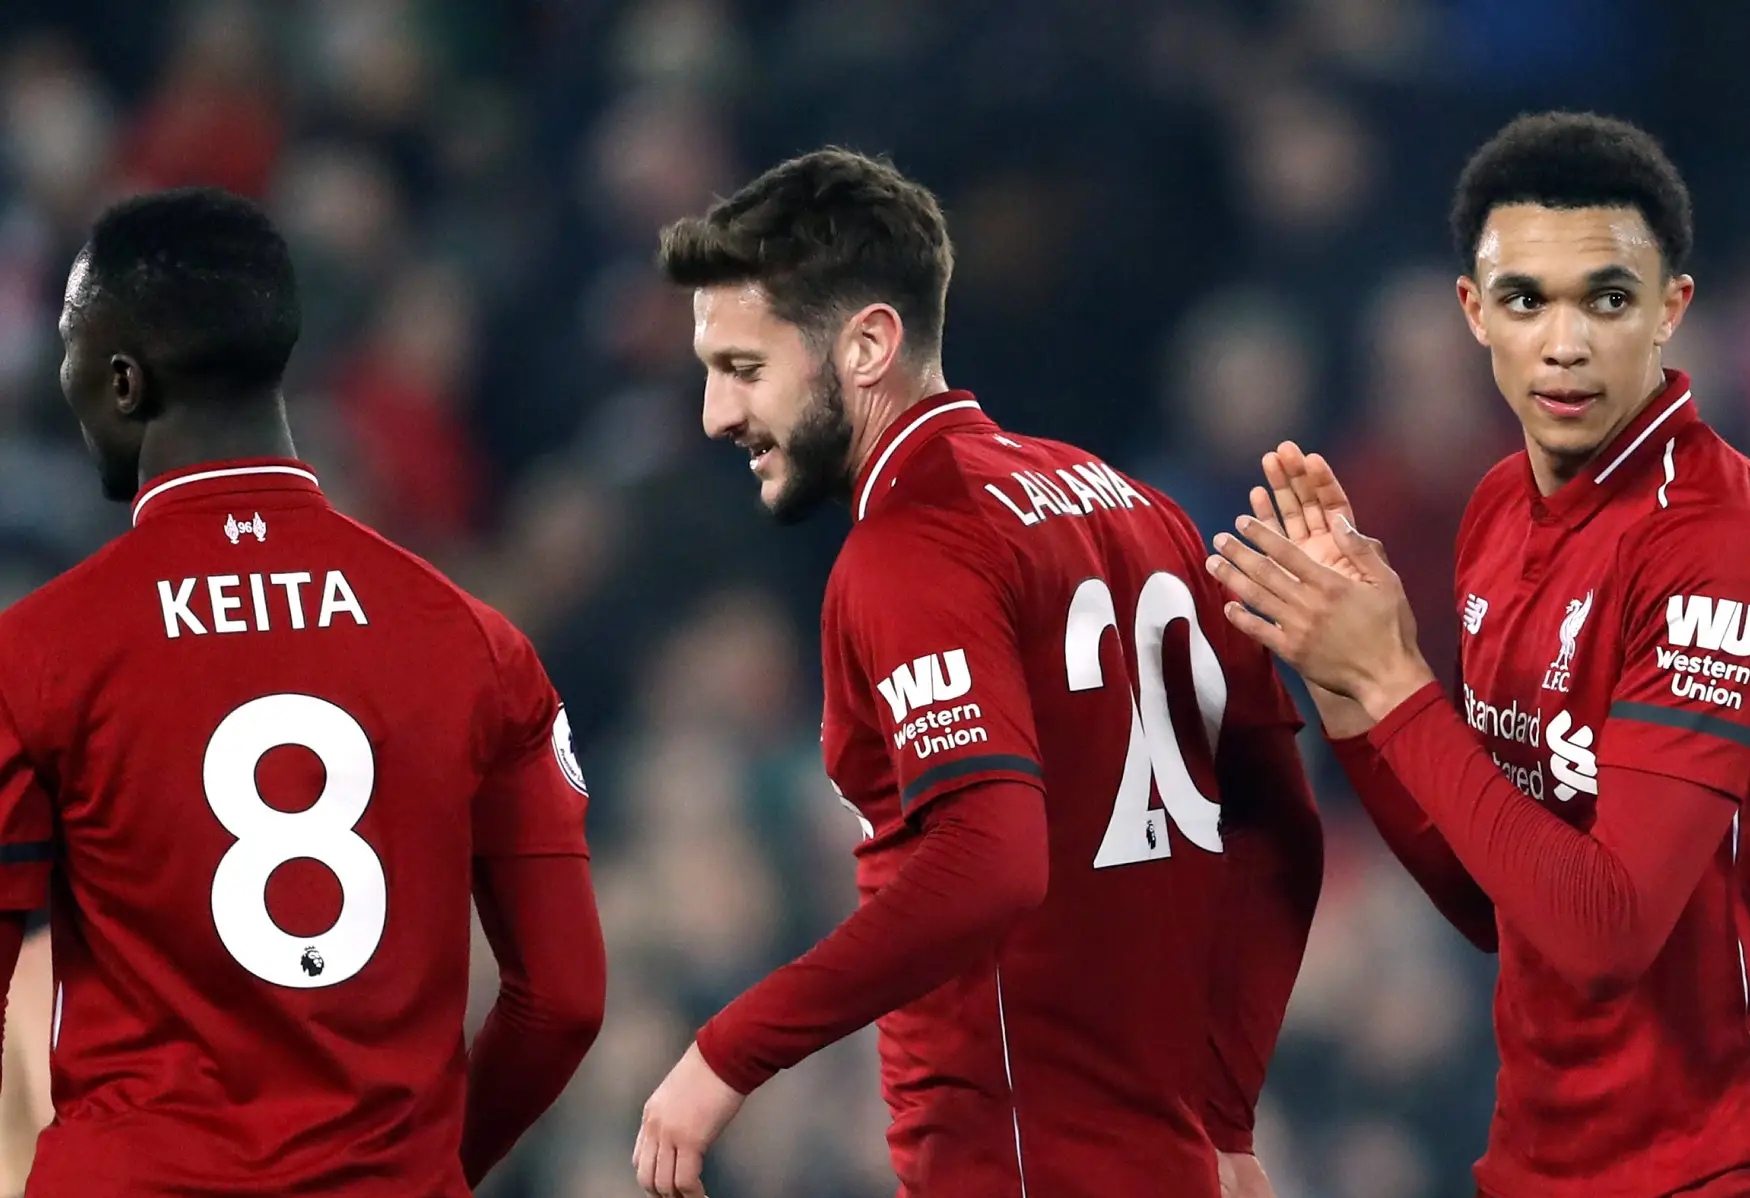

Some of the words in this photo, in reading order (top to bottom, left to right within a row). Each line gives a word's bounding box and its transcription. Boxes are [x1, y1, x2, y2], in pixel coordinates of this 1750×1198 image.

[984, 461, 1151, 526] LALLANA
[237, 521, 253, 534] 96
[156, 569, 369, 638] KEITA
[877, 648, 972, 724] WU
[1656, 646, 1750, 684] Western
[1671, 672, 1742, 710] Union
[893, 703, 982, 750] Western
[913, 726, 988, 759] Union
[1064, 571, 1228, 869] 20
[203, 692, 387, 989] 8
